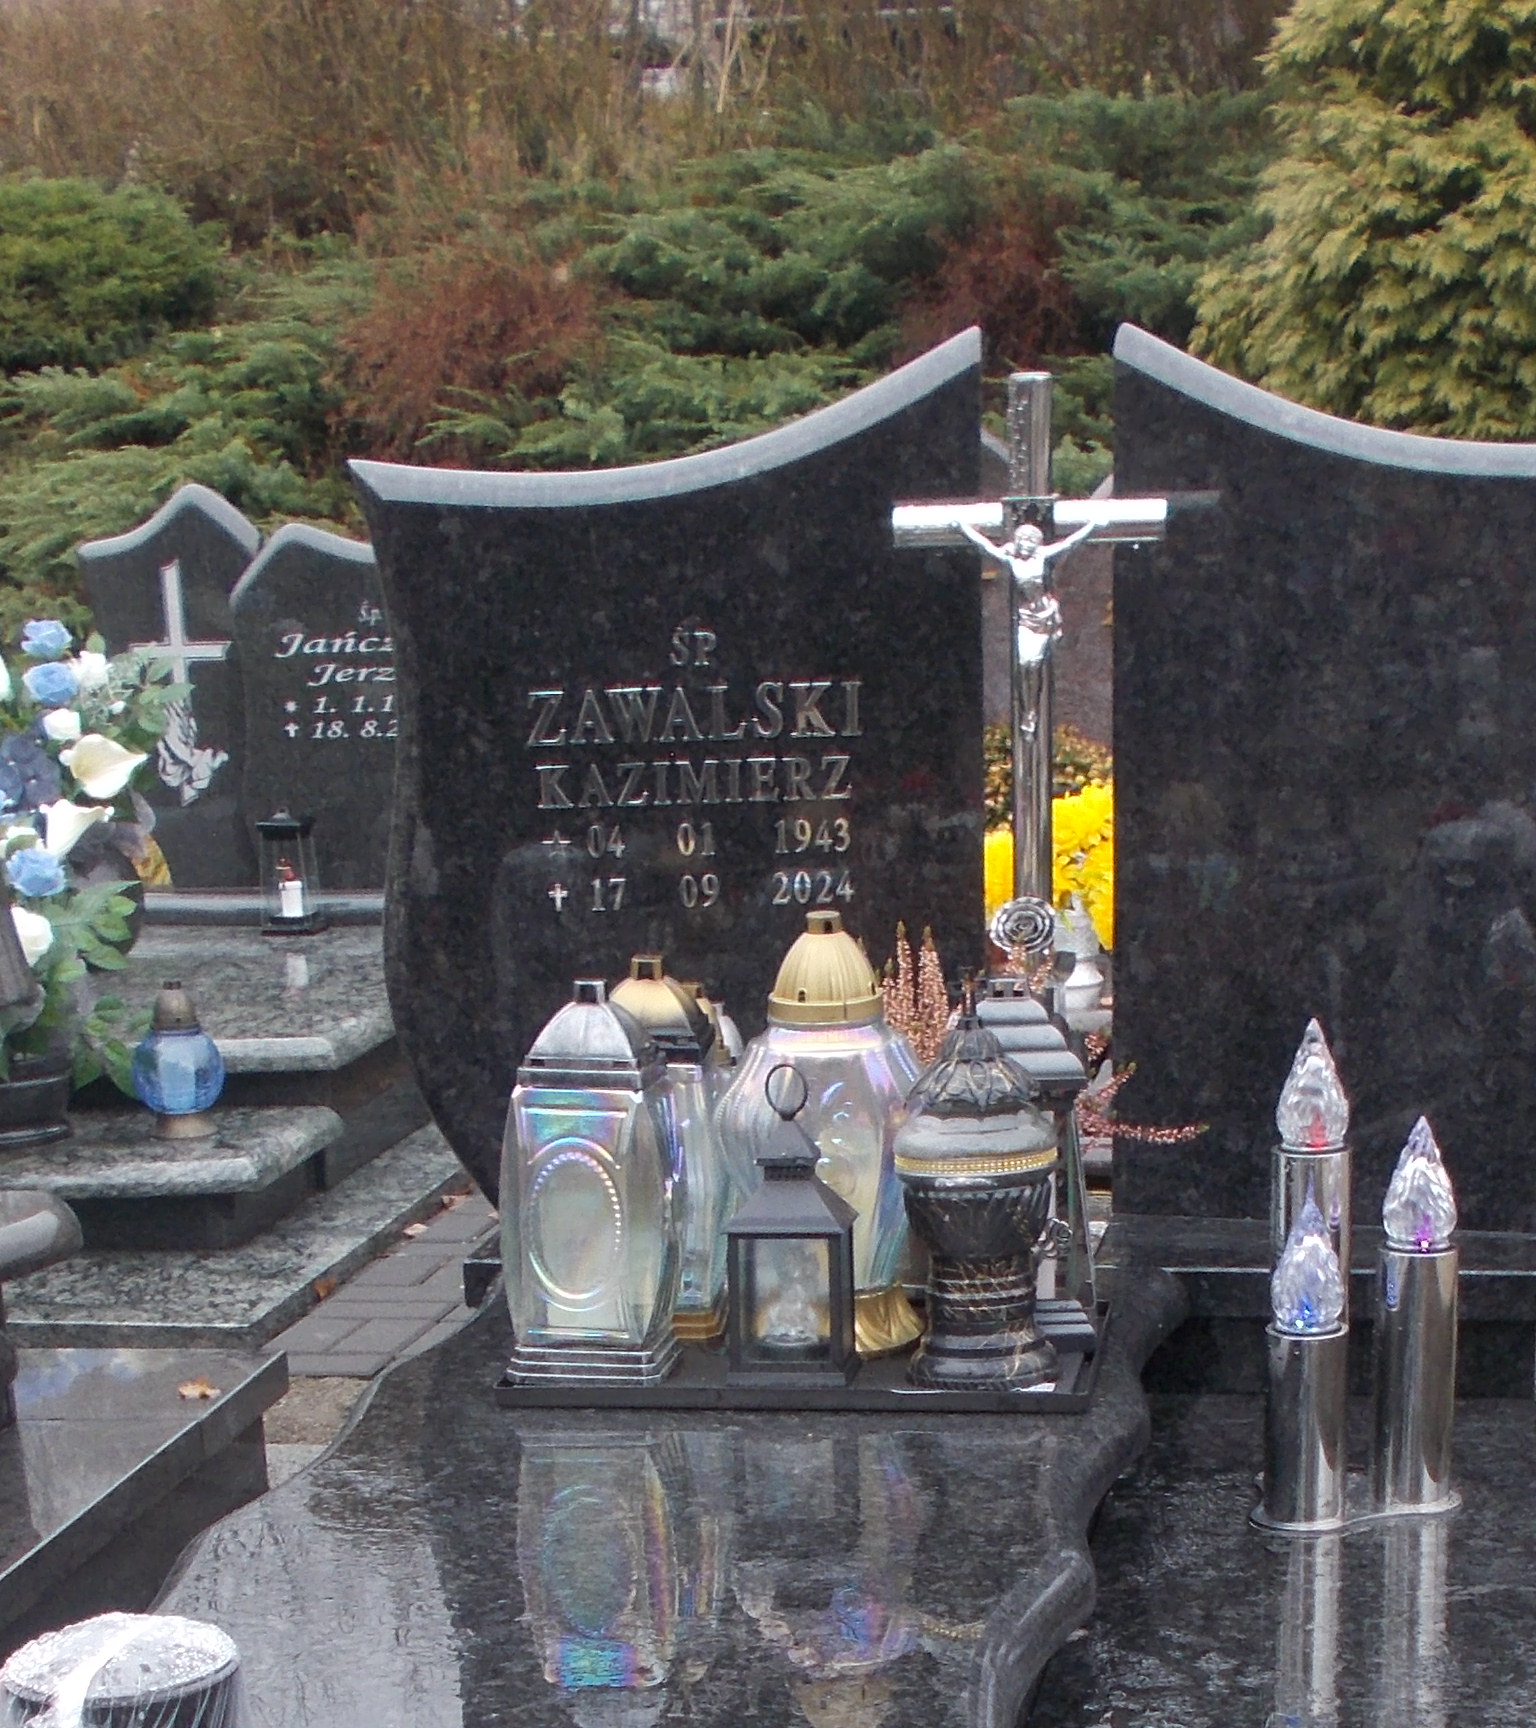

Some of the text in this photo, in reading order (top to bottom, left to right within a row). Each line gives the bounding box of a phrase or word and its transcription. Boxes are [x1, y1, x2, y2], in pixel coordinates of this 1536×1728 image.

[306, 663, 397, 687] Jerz
[526, 680, 863, 747] ZAWALSKI
[534, 755, 853, 809] KAZIMIERZ
[586, 818, 853, 859] 04 01 1943
[590, 869, 855, 912] 17 09 2024
